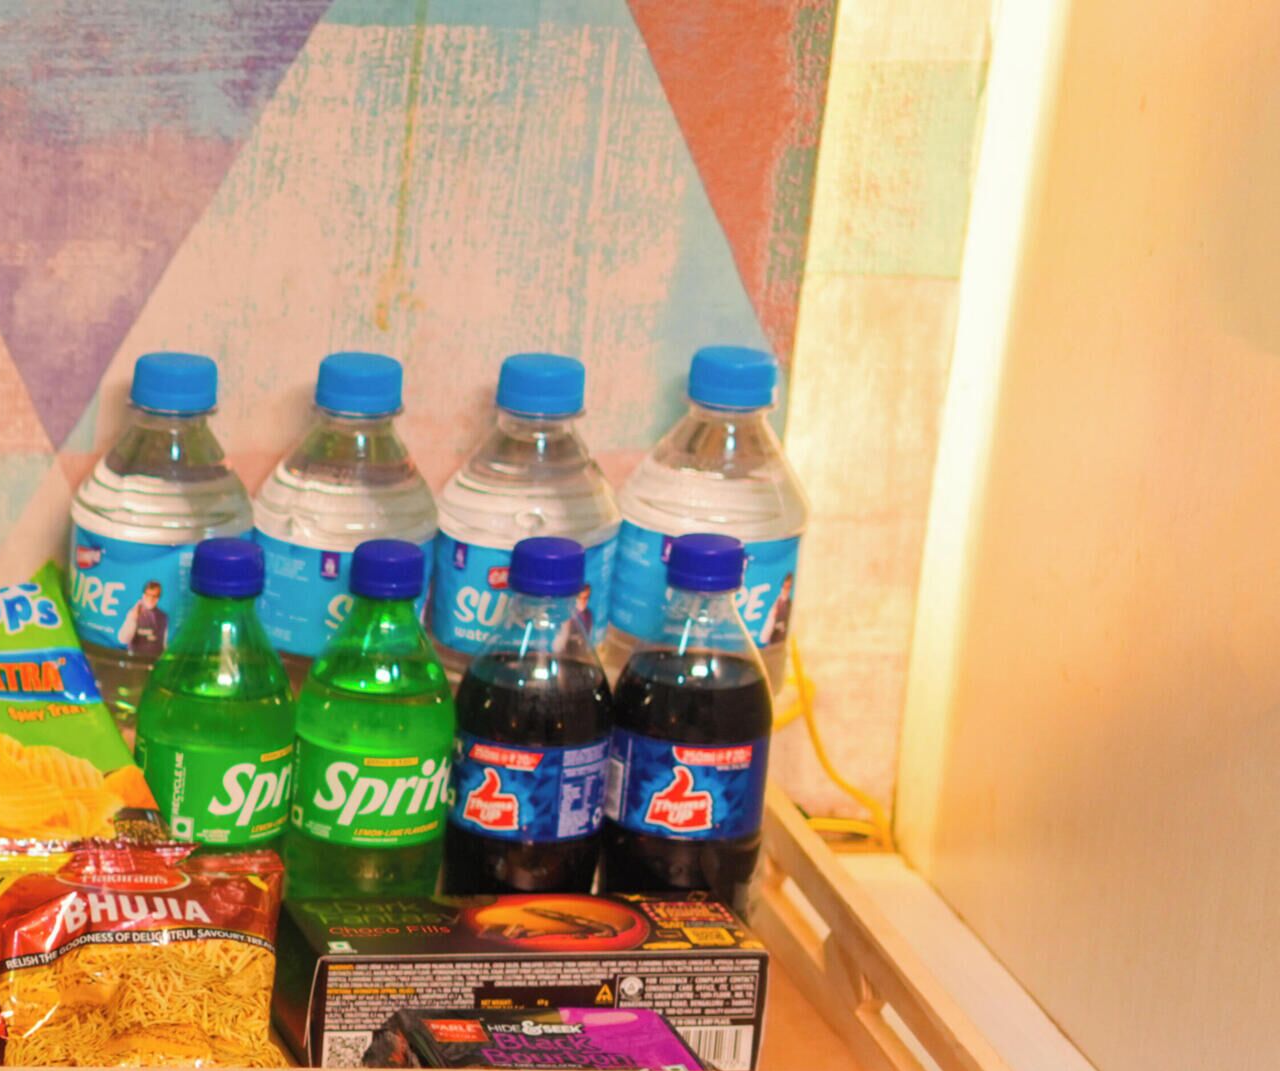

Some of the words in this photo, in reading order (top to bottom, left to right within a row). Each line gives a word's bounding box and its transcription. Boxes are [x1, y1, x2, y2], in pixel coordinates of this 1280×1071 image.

[72, 572, 125, 616] URE
[208, 762, 292, 827] Spr
[313, 757, 452, 826] Sprit
[63, 893, 212, 935] BHUJIA
[329, 926, 400, 937] Choco
[405, 925, 452, 934] Fills
[5, 955, 39, 970] RELISH
[38, 951, 58, 965] THE
[59, 931, 114, 955] GOODNESS
[115, 931, 132, 943] OF
[197, 929, 245, 942] SAVOURY
[481, 1048, 638, 1067] Bourbon
[492, 1032, 596, 1051] Black
